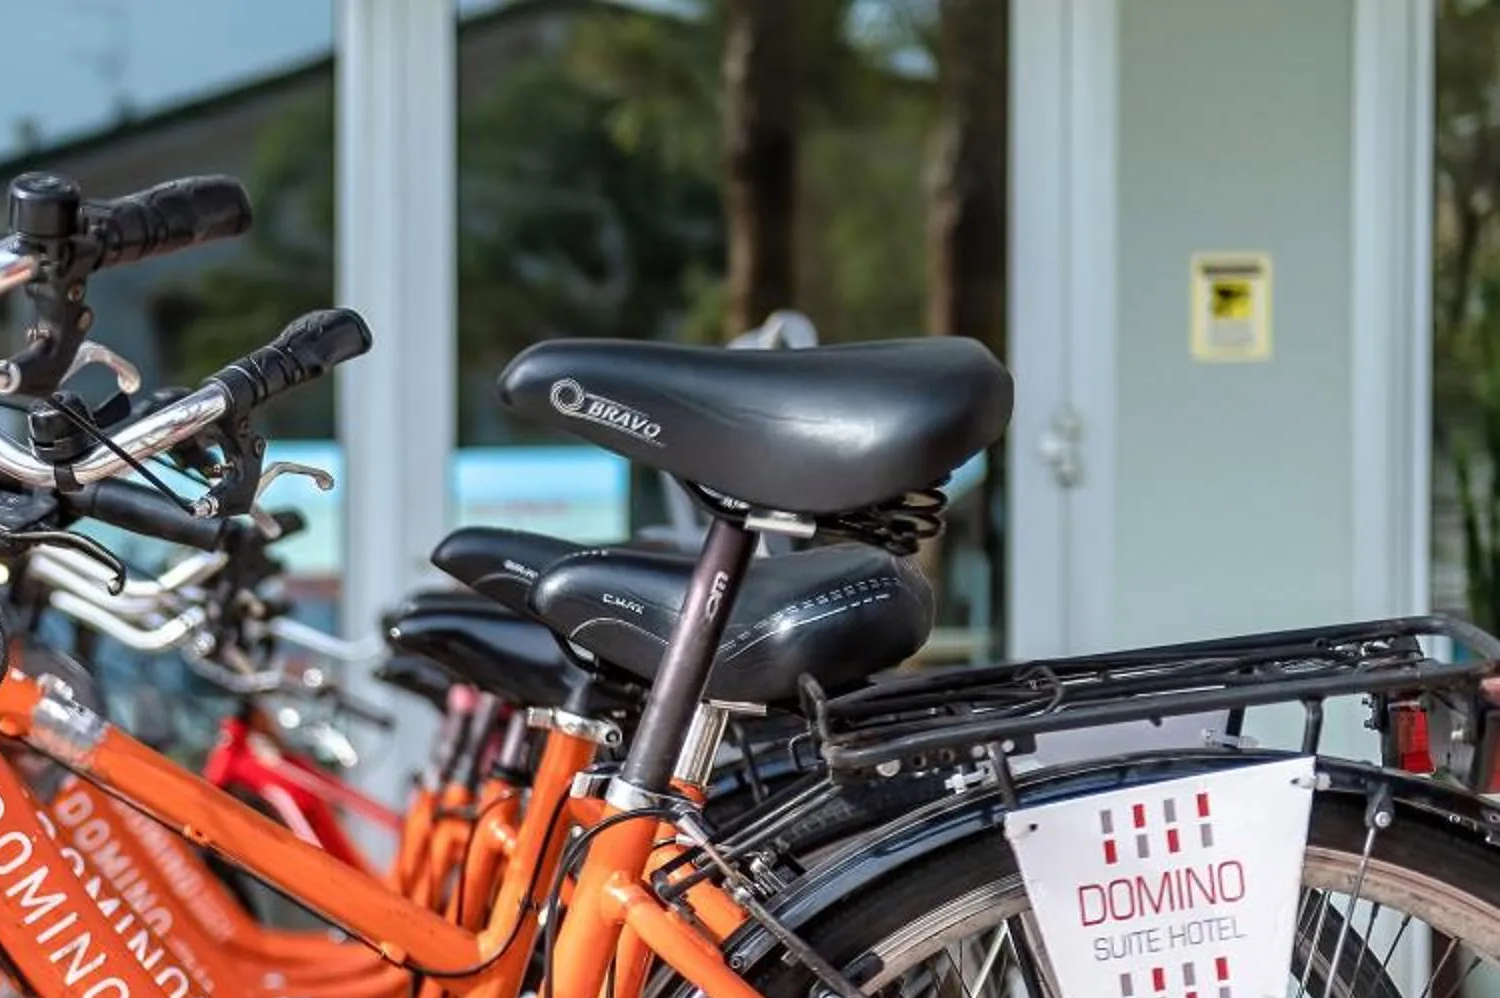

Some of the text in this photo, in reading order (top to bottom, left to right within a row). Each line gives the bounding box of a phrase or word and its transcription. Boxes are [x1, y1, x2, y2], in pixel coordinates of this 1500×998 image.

[586, 400, 661, 438] BRAVO
[1078, 860, 1245, 927] DOMINO
[1093, 916, 1249, 961] SUITE HOTEL
